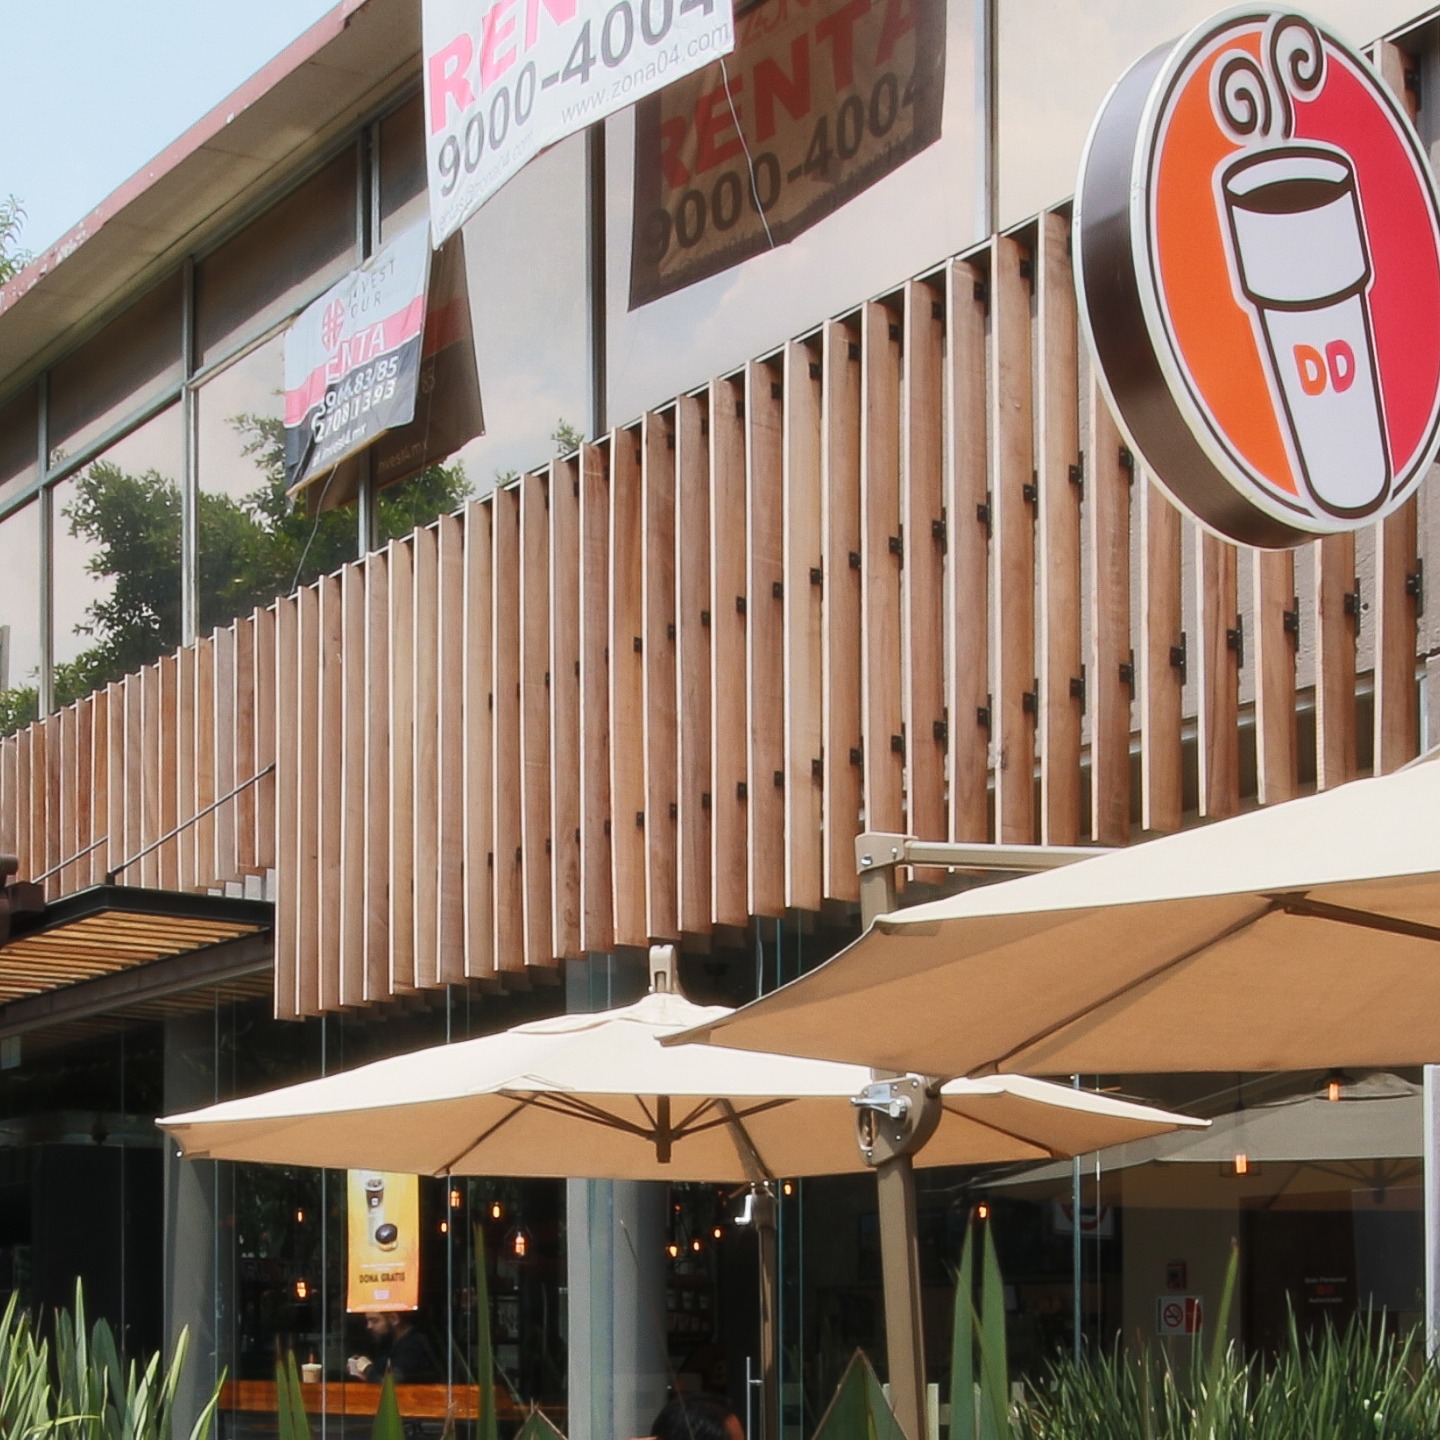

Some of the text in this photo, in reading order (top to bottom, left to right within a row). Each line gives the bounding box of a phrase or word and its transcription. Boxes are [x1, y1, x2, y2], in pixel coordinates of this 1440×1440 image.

[438, 0, 714, 197] 9000-400
[561, 23, 730, 124] www.zona04.com
[324, 322, 386, 382] ENTA
[1293, 339, 1355, 396] DD
